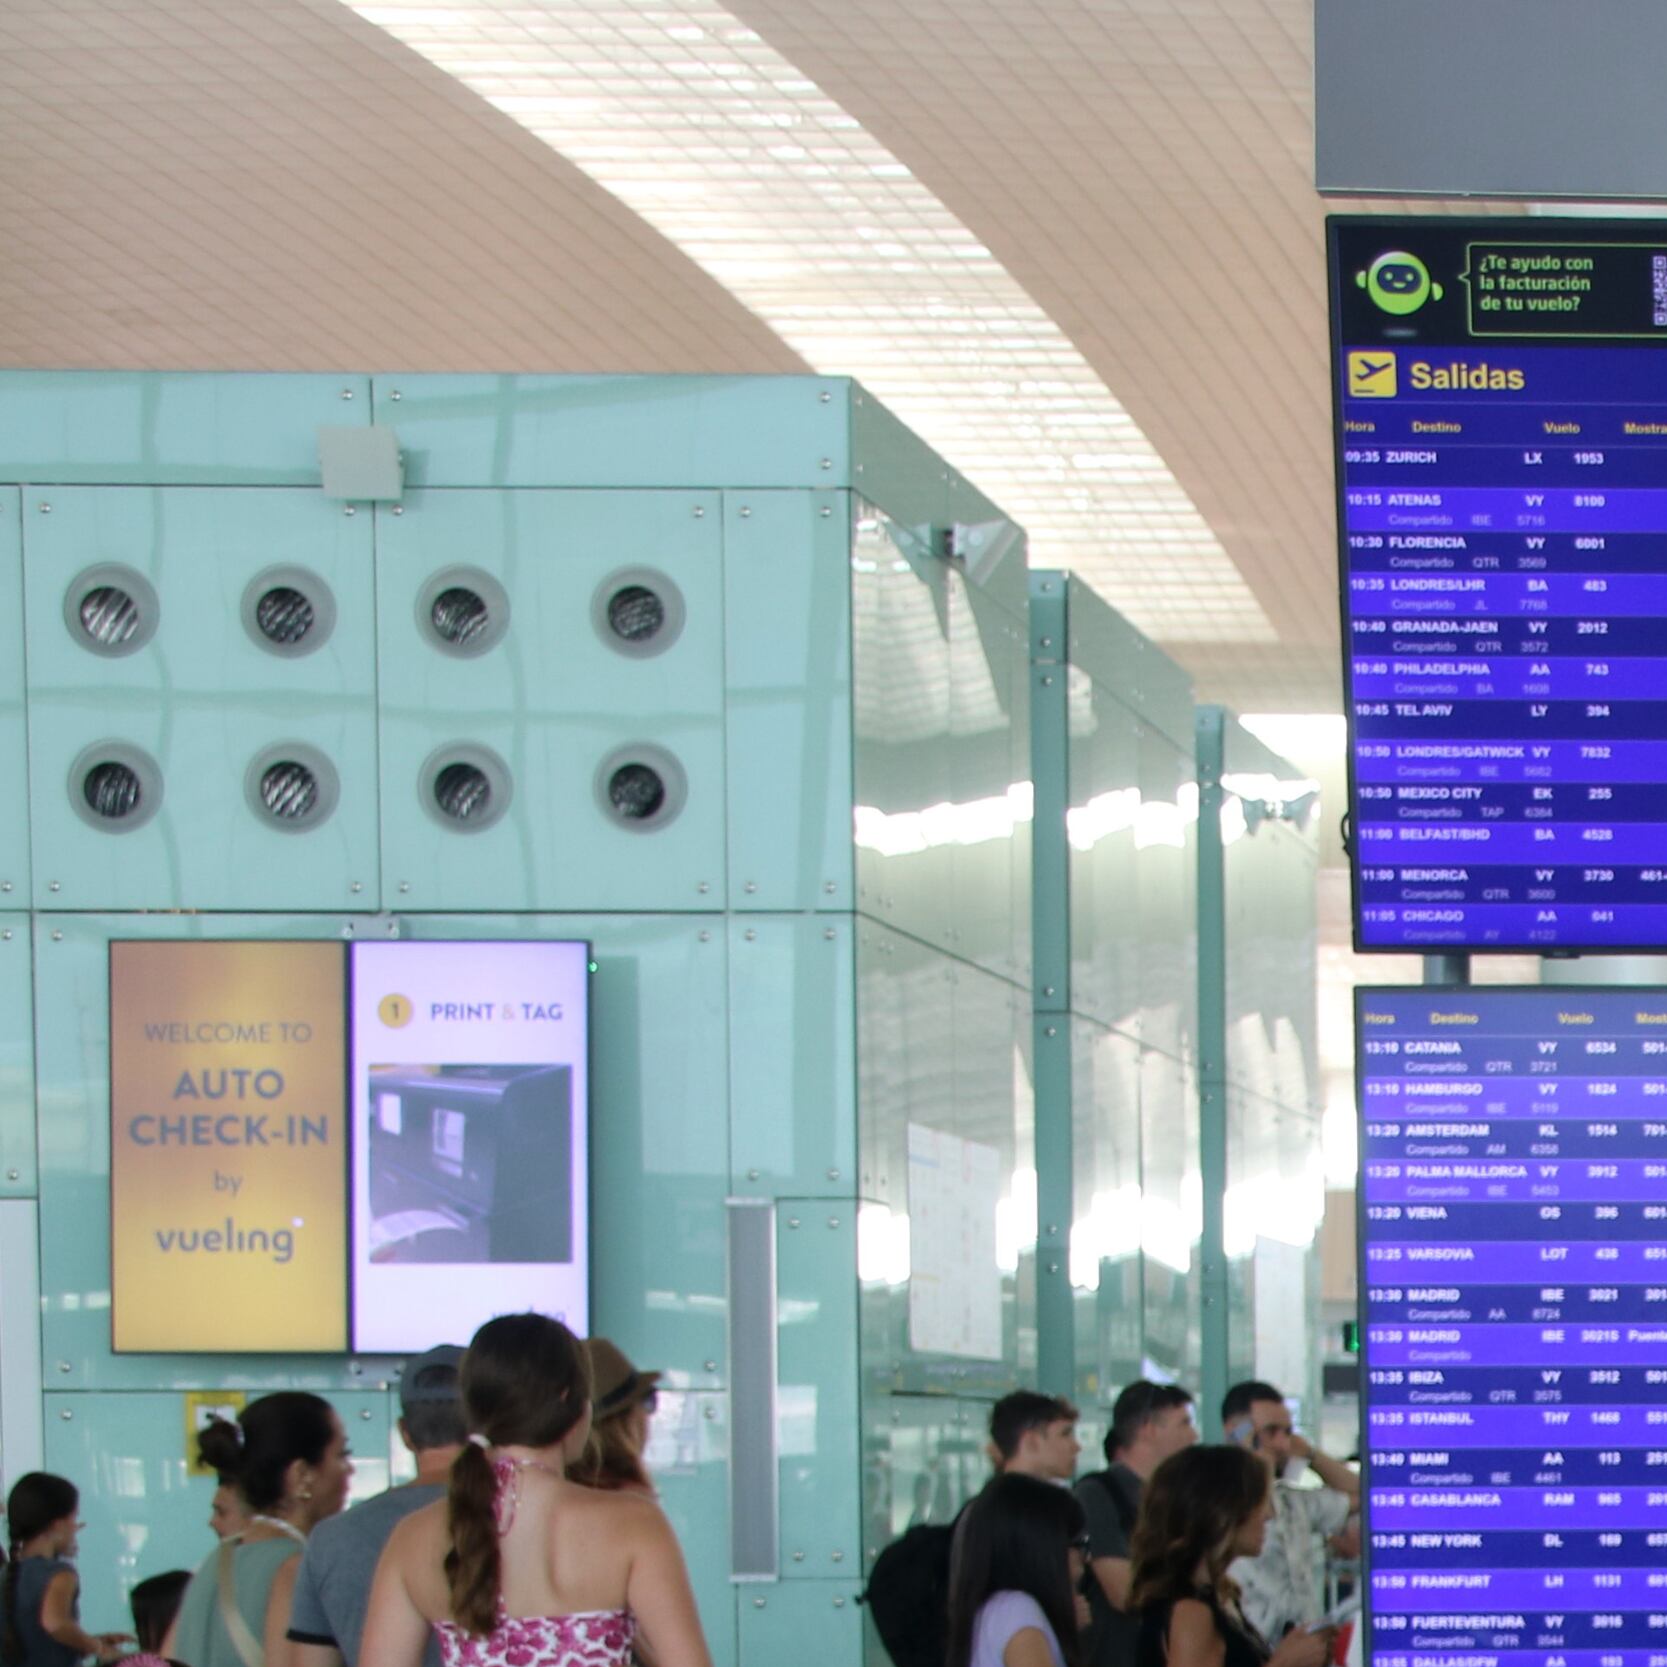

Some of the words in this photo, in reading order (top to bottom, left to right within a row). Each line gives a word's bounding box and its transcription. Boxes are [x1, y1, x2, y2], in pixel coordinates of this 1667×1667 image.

[1479, 255, 1507, 272] ¿Te
[1511, 256, 1560, 273] ayudo
[1564, 257, 1593, 271] con
[1480, 275, 1495, 290] la
[1499, 275, 1590, 292] facturación
[1481, 296, 1501, 311] de
[1505, 297, 1523, 311] tu
[1528, 296, 1580, 311] vuelo?
[1410, 362, 1525, 391] Salidas
[1345, 421, 1375, 433] Hora
[1413, 422, 1461, 434] Destino
[1544, 422, 1580, 435] Vuelo
[1346, 451, 1380, 464] 09:35
[1386, 452, 1437, 464] ZURICH
[1525, 453, 1542, 464] LX
[1574, 453, 1604, 465] 1953
[1389, 537, 1466, 549] FLORENCIA
[1392, 621, 1498, 634] GRANADA-JAEN
[1396, 706, 1420, 717] TEL
[1422, 706, 1452, 717] AVIV
[390, 1002, 399, 1019] 1
[430, 1003, 494, 1022] PRINT
[522, 1003, 563, 1022] TAG
[1365, 1012, 1395, 1025] Hora
[1430, 1013, 1478, 1025] Destino
[1559, 1013, 1594, 1025] Vuelo
[144, 1023, 271, 1044] WELCOME
[280, 1023, 312, 1043] TO
[1405, 1042, 1461, 1054] CATANIA
[173, 1069, 285, 1099] AUTO
[129, 1115, 328, 1146] CHECK-IN
[214, 1171, 242, 1196] by
[156, 1218, 294, 1263] vueling
[1410, 1453, 1449, 1465] MIAMI
